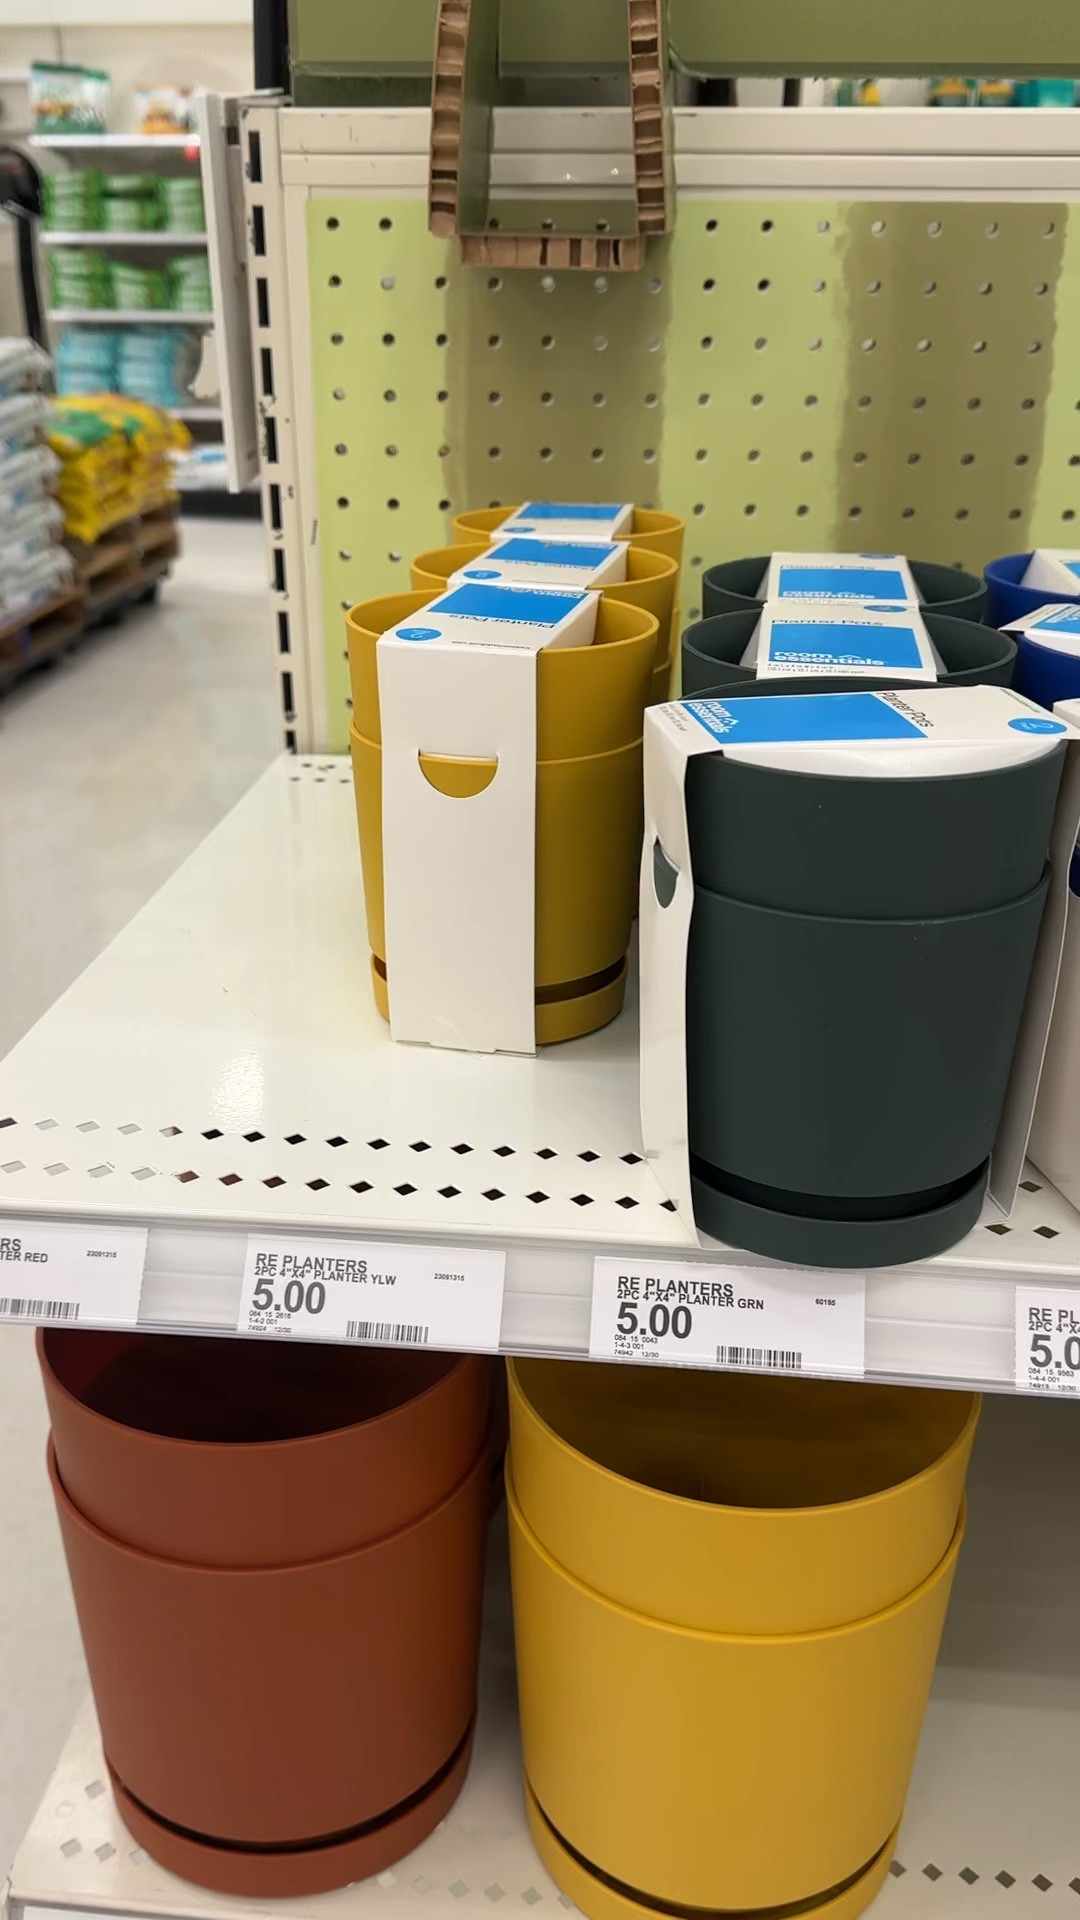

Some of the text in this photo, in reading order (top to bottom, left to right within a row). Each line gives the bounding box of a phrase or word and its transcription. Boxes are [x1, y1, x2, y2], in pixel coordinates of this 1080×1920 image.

[449, 614, 556, 629] Planter Pots
[774, 651, 833, 659] room
[774, 656, 885, 666] essentials
[876, 691, 935, 729] Planter Pots
[24, 1252, 49, 1263] RED
[256, 1253, 367, 1274] RE PLANTERS
[254, 1266, 397, 1285] 2PC 4"X4" PLANTER YLW
[252, 1278, 326, 1314] 5.00
[618, 1276, 734, 1298] RE PLANTERS
[617, 1289, 764, 1310] 2PC 4"X4" PLANTER GRN
[617, 1301, 692, 1339] 5.00
[1029, 1307, 1080, 1325] RE PL
[1028, 1321, 1053, 1332] 2PC
[1030, 1333, 1080, 1371] 5.0
